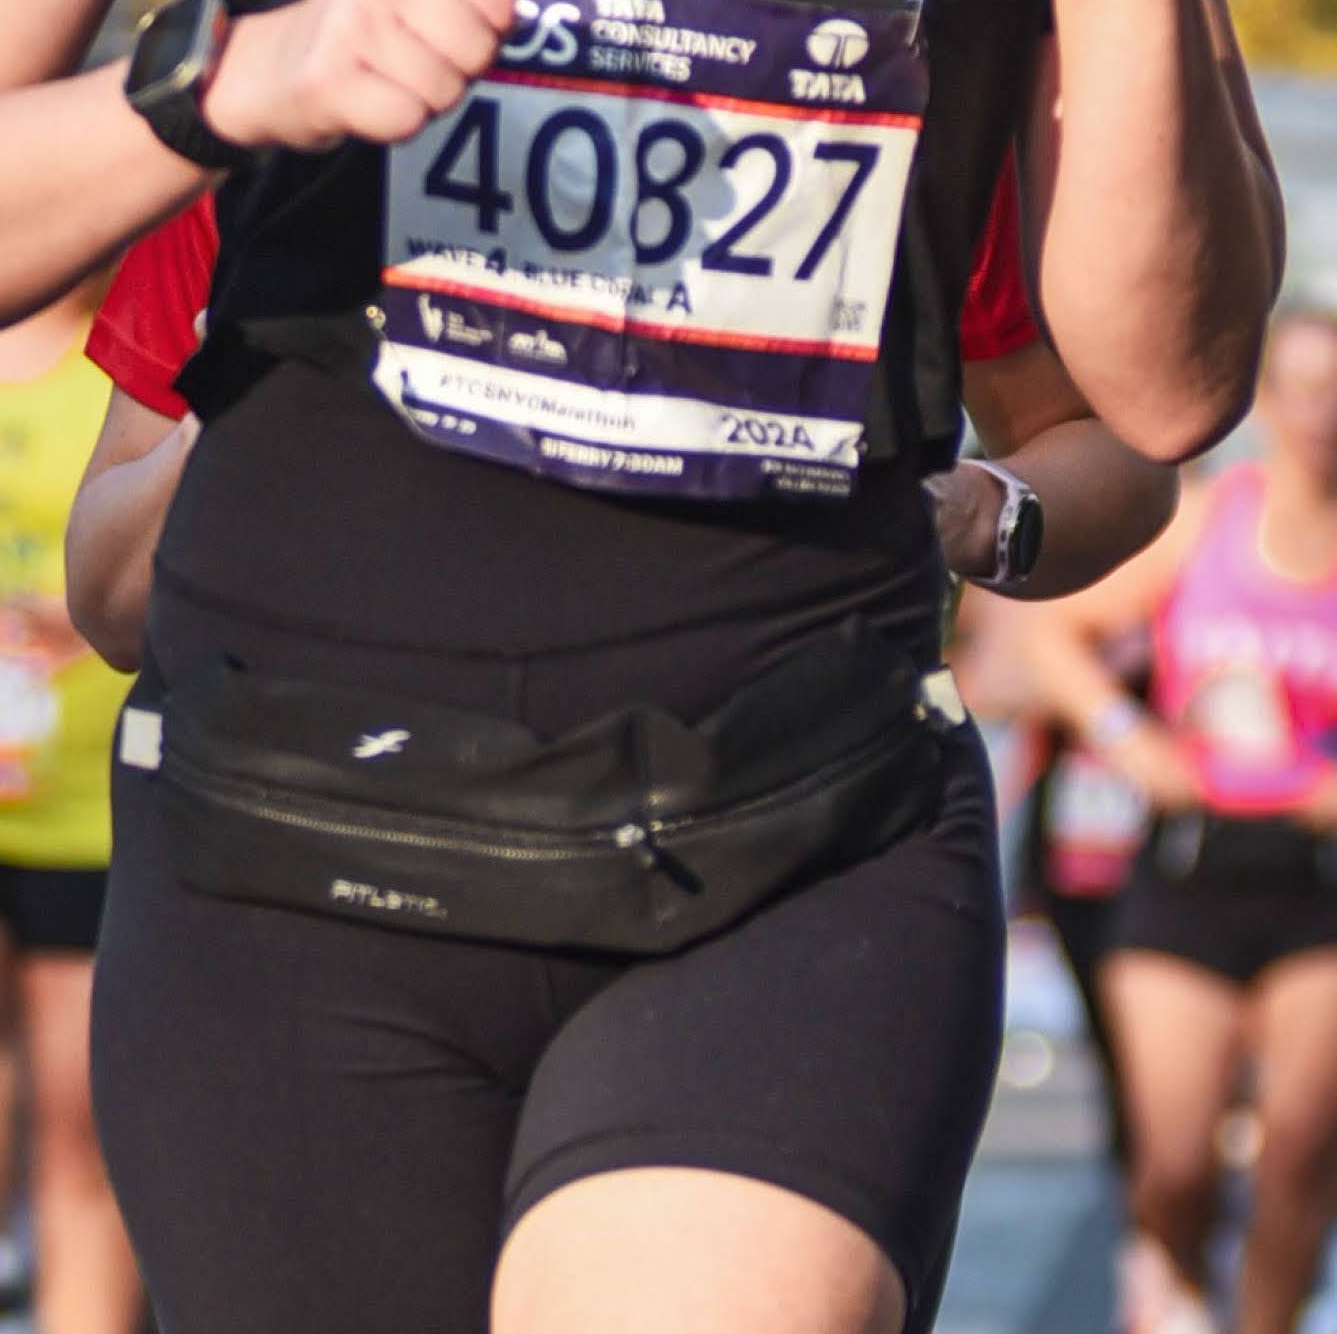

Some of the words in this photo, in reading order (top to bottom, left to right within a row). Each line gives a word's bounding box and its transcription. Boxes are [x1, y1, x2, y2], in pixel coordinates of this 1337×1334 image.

[590, 18, 756, 64] CONSULTANCY
[589, 45, 692, 82] SERVICES
[789, 69, 866, 103] TATA
[424, 97, 881, 281] 40827
[666, 281, 693, 315] A
